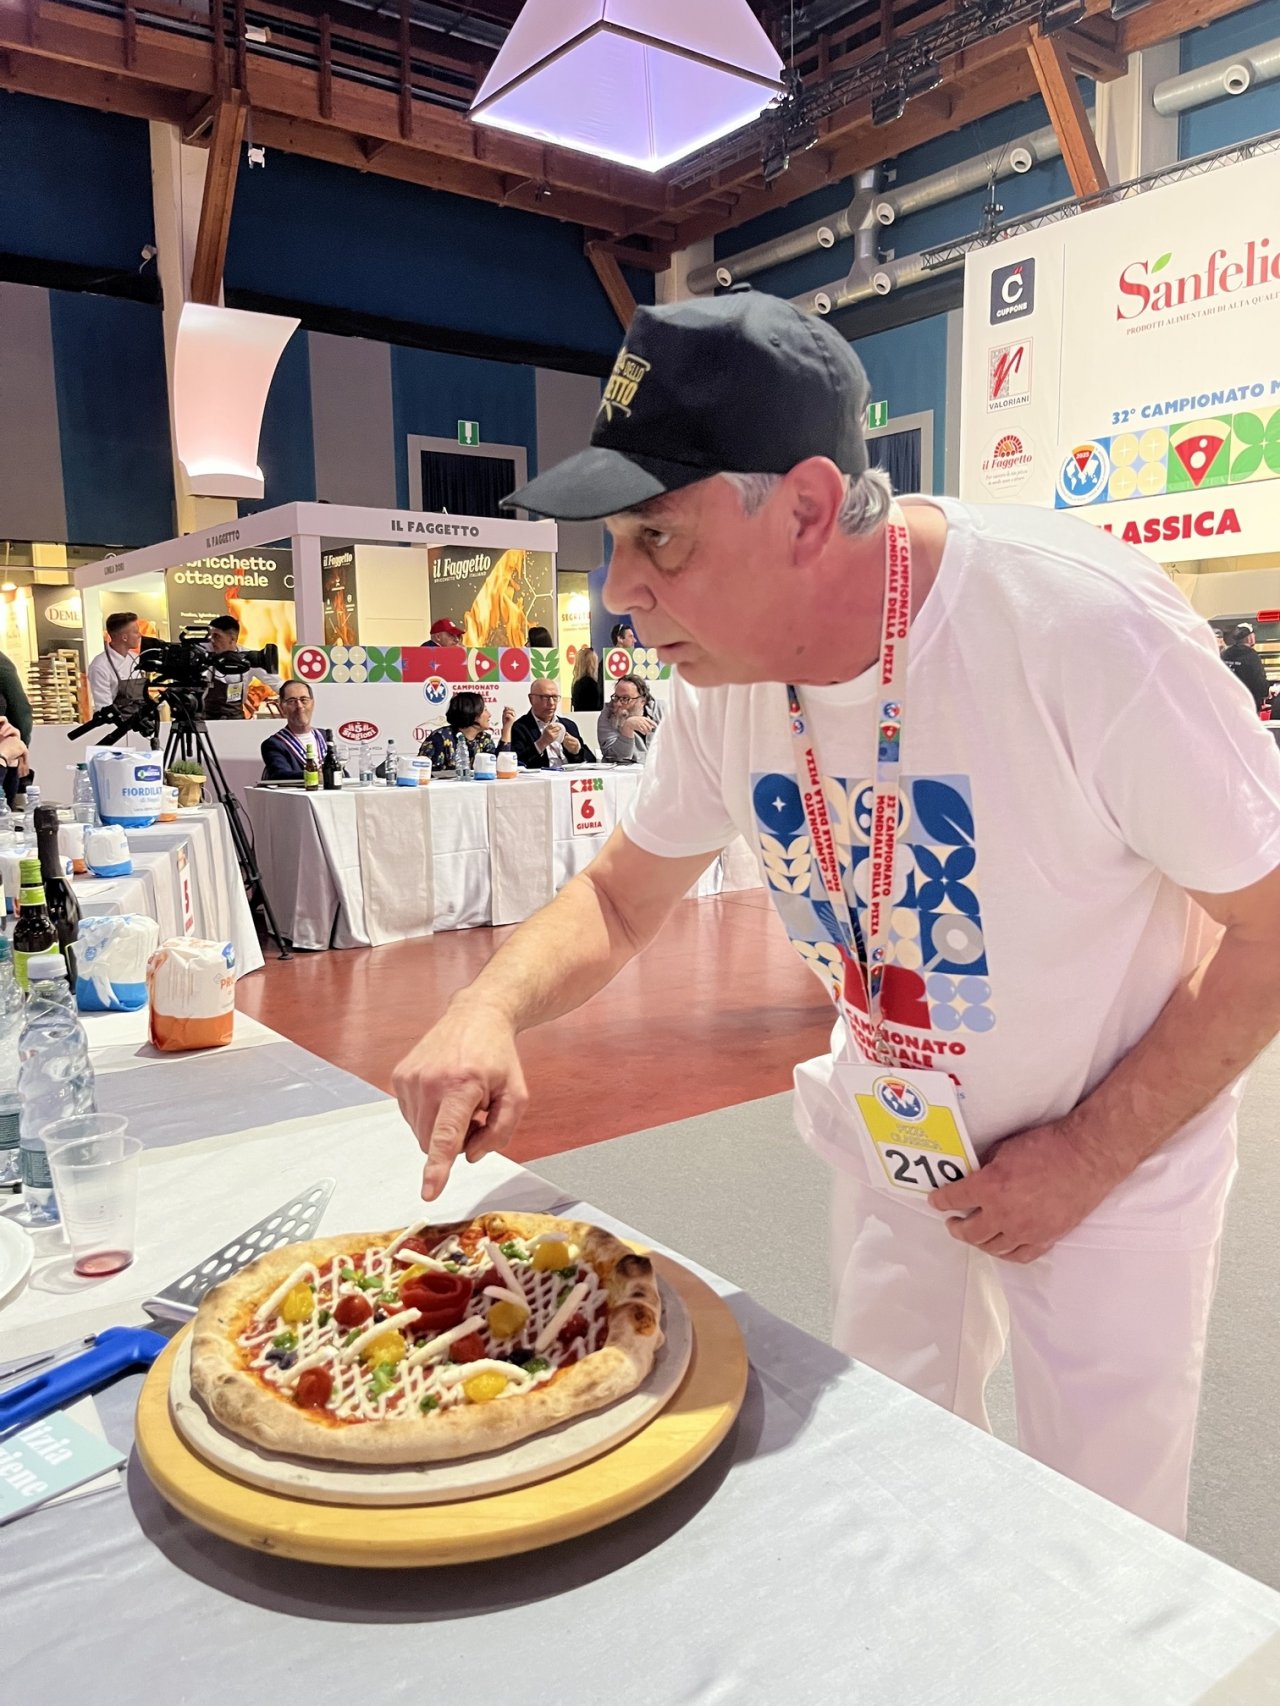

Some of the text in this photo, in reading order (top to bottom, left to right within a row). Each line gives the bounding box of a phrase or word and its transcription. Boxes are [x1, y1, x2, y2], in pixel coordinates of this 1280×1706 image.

[996, 301, 1028, 318] CUPPONE
[1126, 319, 1165, 335] PRODOTTI
[1165, 308, 1216, 326] ALIMENTARI
[1227, 299, 1250, 311] ALTA
[989, 396, 1030, 411] VALORIANI
[1112, 408, 1136, 425] 32°
[1141, 383, 1265, 419] CAMPIONATO
[211, 530, 240, 547] FAGGETTO
[391, 520, 480, 538] IL FAGGETTO
[1095, 508, 1242, 545] ASSICA
[174, 569, 269, 590] ottagonale
[433, 553, 491, 580] il Faggetto
[882, 524, 898, 685] MONDIALE DELLA PIZZA
[897, 546, 909, 639] CAMPIONATO
[576, 821, 602, 830] GIURIA
[581, 799, 595, 819] 6
[805, 748, 841, 892] MONDIALE DELLA PIZZA
[804, 792, 829, 872] CAMPIONATO
[871, 795, 885, 936] MONDIALE DELLA PIZZA
[882, 816, 895, 896] CAMPIONATO
